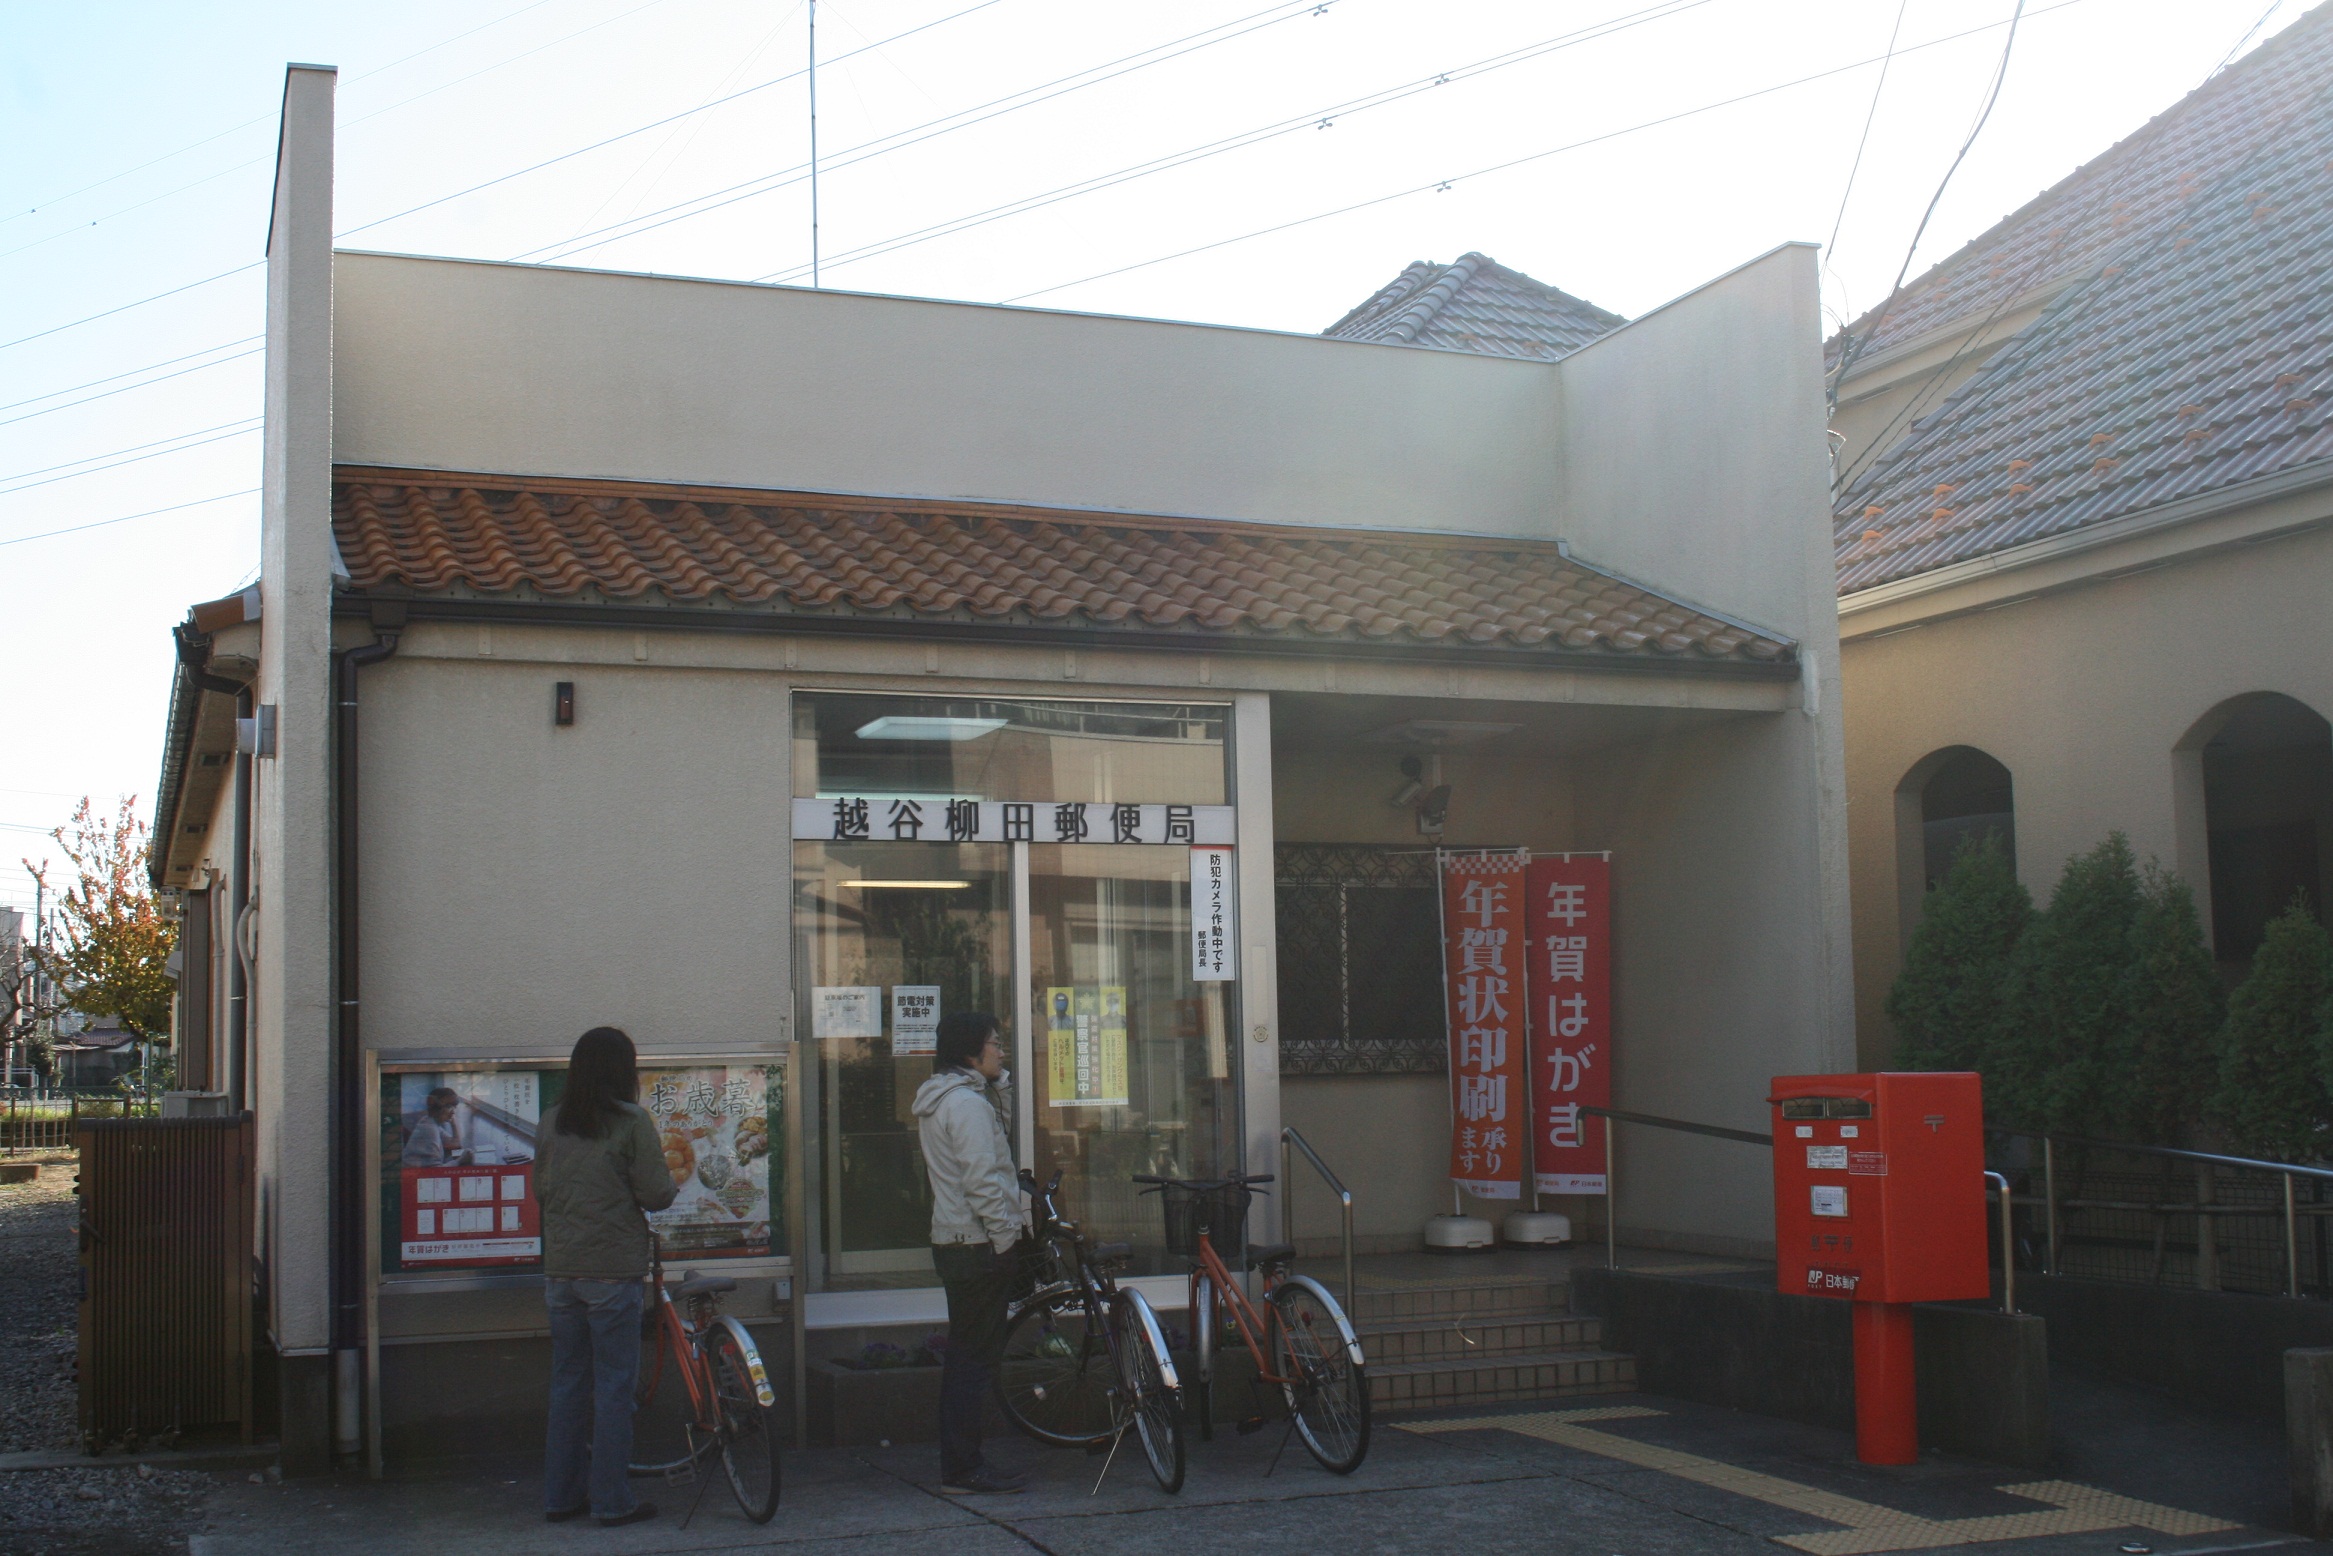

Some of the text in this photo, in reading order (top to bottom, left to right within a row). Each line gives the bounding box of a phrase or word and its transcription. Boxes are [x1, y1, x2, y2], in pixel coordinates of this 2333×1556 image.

[833, 797, 1196, 844] 越谷柳田郵便局
[1210, 854, 1223, 973] 防犯カメラ作動中です
[1198, 931, 1207, 967] 郵便局長
[897, 995, 935, 1007] 節電対策
[902, 1007, 930, 1018] 実施中
[1457, 879, 1510, 1123] 年賀状印刷
[1545, 881, 1597, 1148] 年賀はがき
[1076, 1014, 1089, 1094] 警察官巡回中
[649, 1078, 756, 1118] お歳暮
[1458, 1126, 1480, 1174] ます
[1480, 1126, 1508, 1175] 承り
[408, 1244, 449, 1254] 年賀はがき
